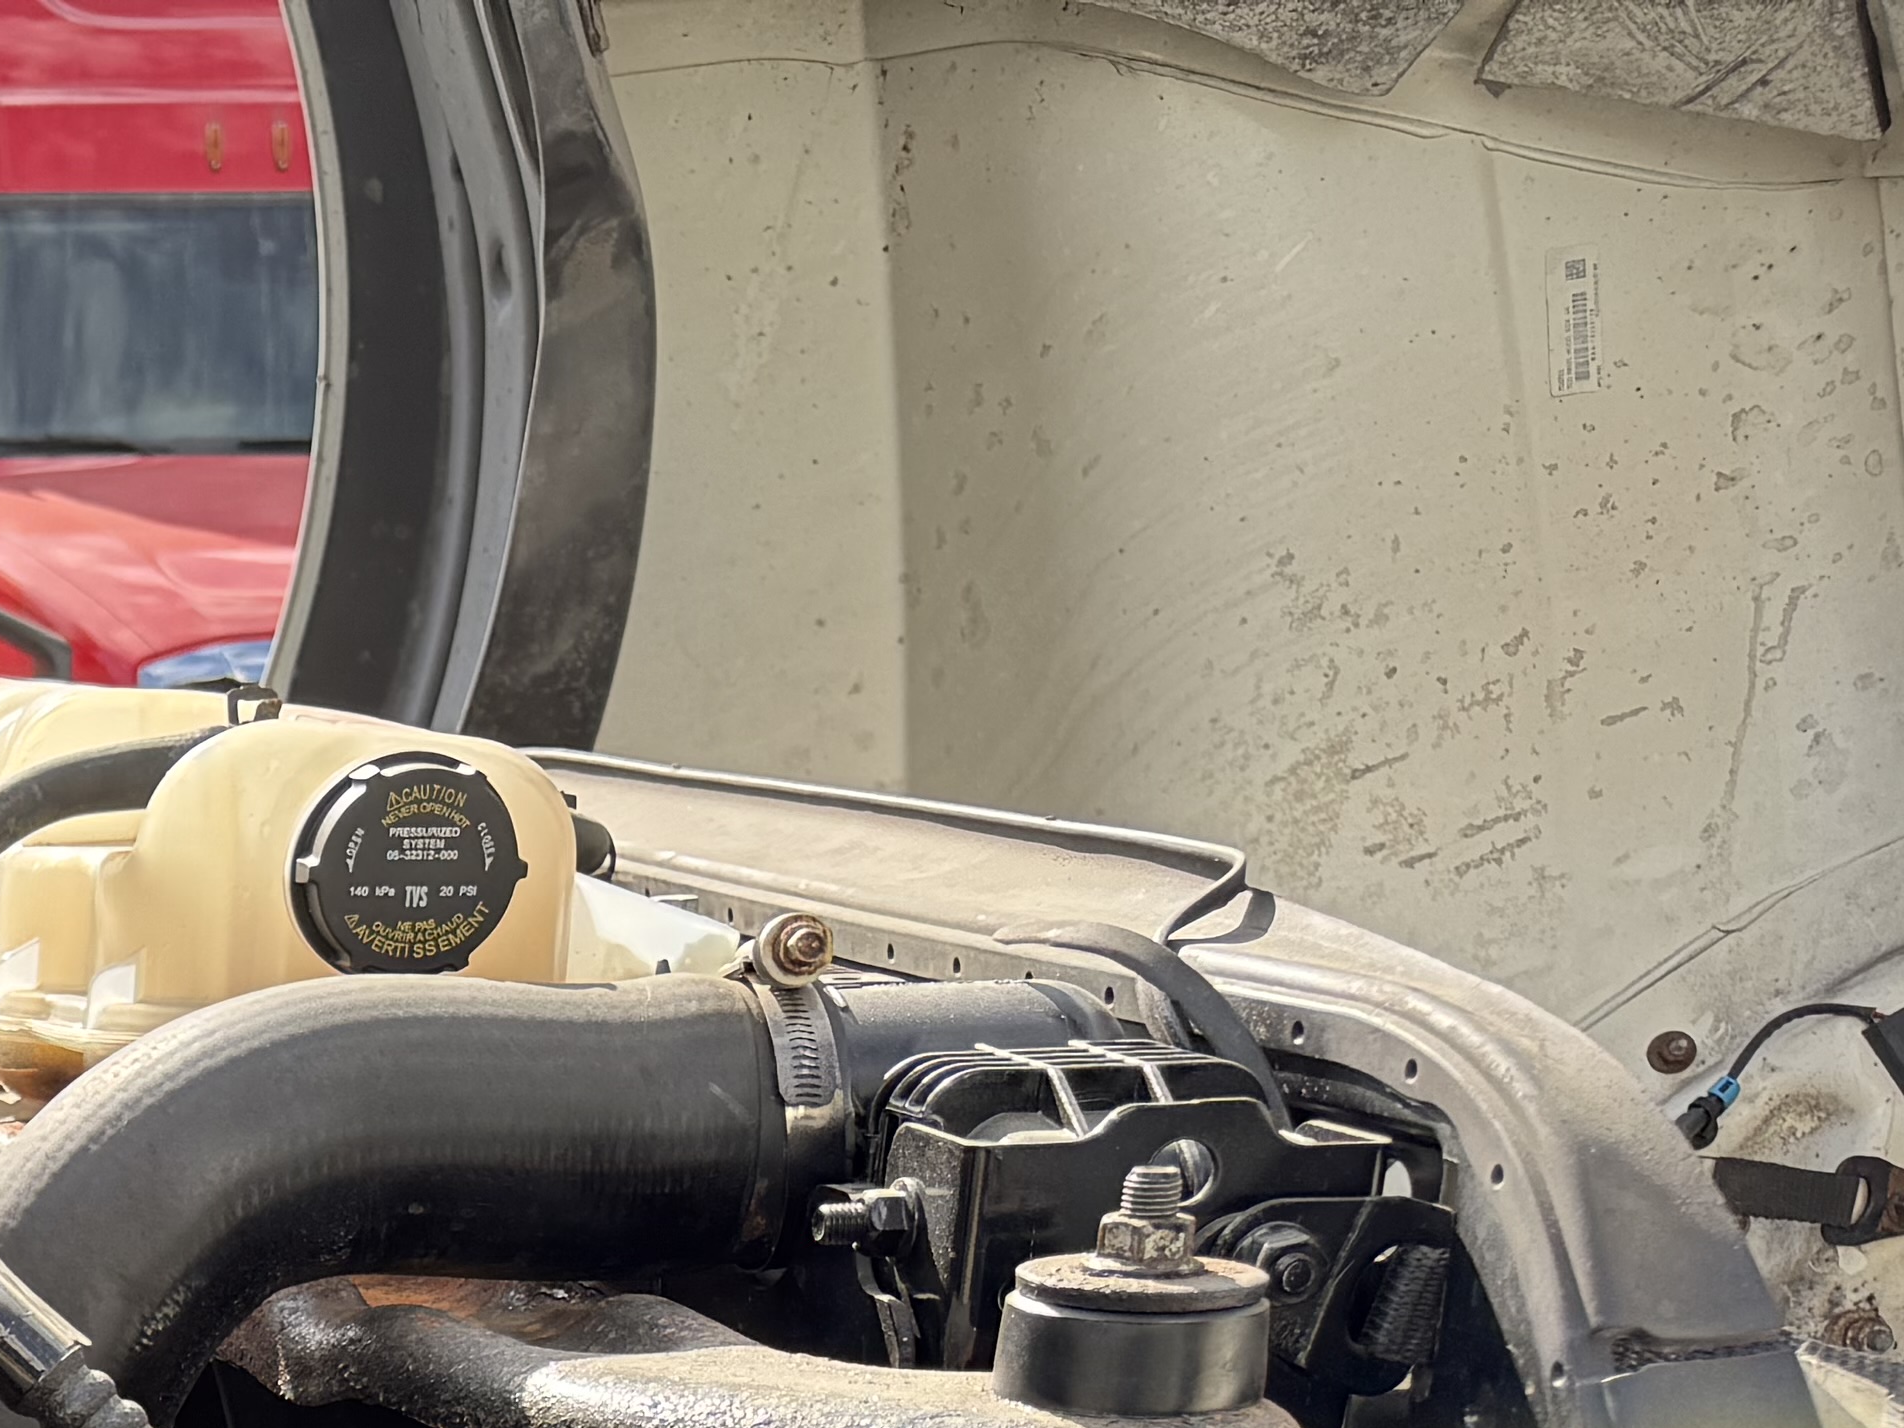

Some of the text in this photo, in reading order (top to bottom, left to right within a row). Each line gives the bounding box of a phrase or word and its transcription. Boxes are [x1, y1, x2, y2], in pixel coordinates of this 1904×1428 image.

[402, 784, 467, 807] CAUTION
[381, 802, 471, 828] NEVER OPEN HOT
[389, 827, 461, 838] PRESSURIZED
[346, 828, 365, 857] OPEN
[402, 838, 445, 849] SYSTEM
[349, 886, 395, 897] 140 kPa
[404, 886, 429, 908] TVS
[439, 886, 477, 897] 20 PSI
[372, 920, 412, 943] OUVRIR
[425, 912, 464, 941] CHAUD
[396, 919, 436, 932] NE PAS
